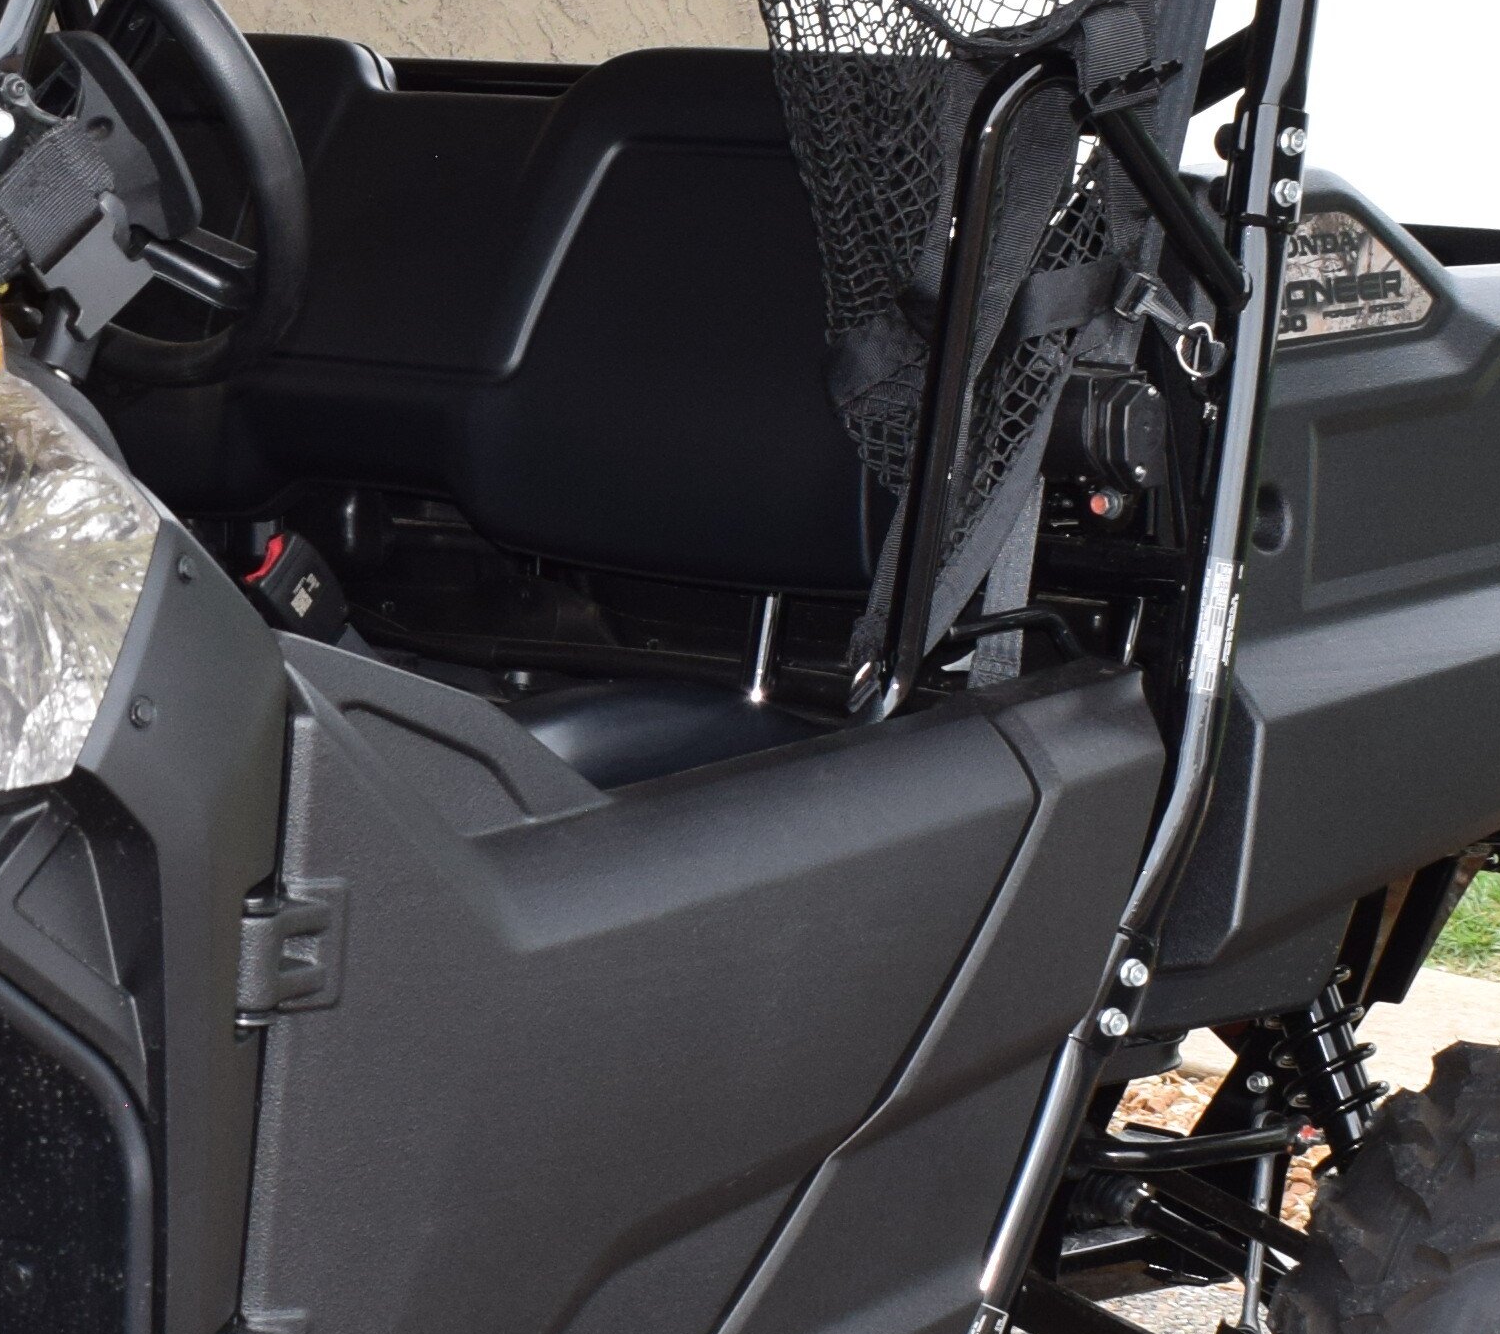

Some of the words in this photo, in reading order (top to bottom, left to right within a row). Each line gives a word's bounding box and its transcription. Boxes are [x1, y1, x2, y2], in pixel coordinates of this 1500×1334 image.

[1287, 231, 1361, 259] ONDA
[1282, 270, 1402, 308] ONEER
[1279, 313, 1308, 334] 00
